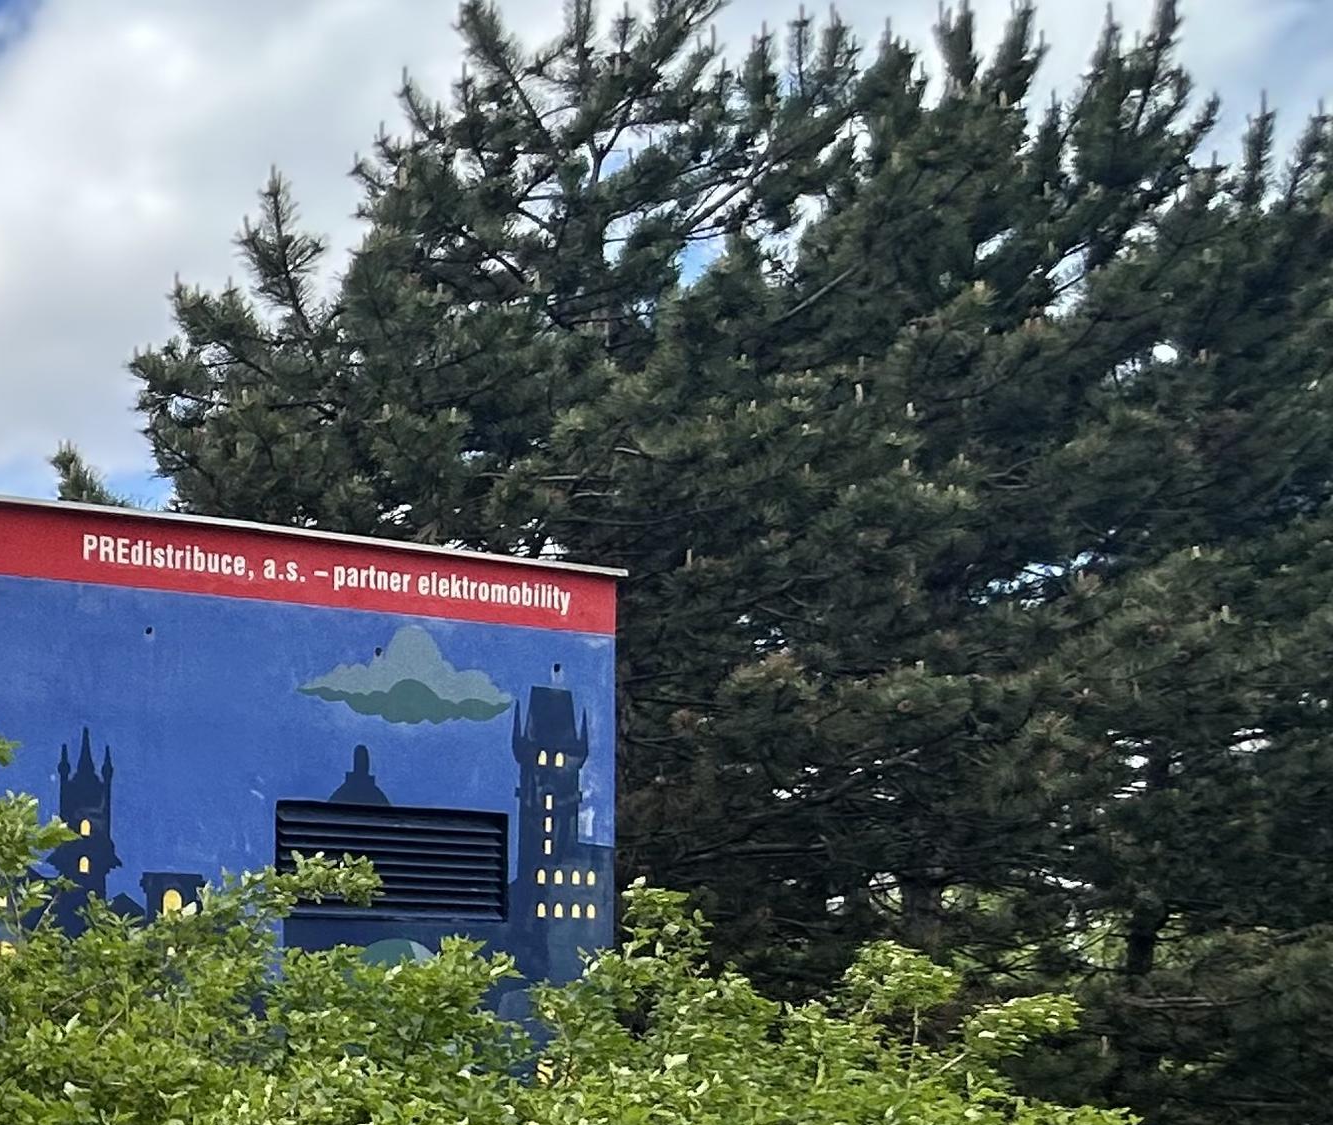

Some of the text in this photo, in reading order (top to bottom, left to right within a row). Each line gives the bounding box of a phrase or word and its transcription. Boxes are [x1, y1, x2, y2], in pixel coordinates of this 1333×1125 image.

[83, 534, 254, 580] PREdistribuce,
[263, 558, 306, 582] a.s.
[332, 565, 411, 593] partner
[417, 572, 571, 615] elektromobility
